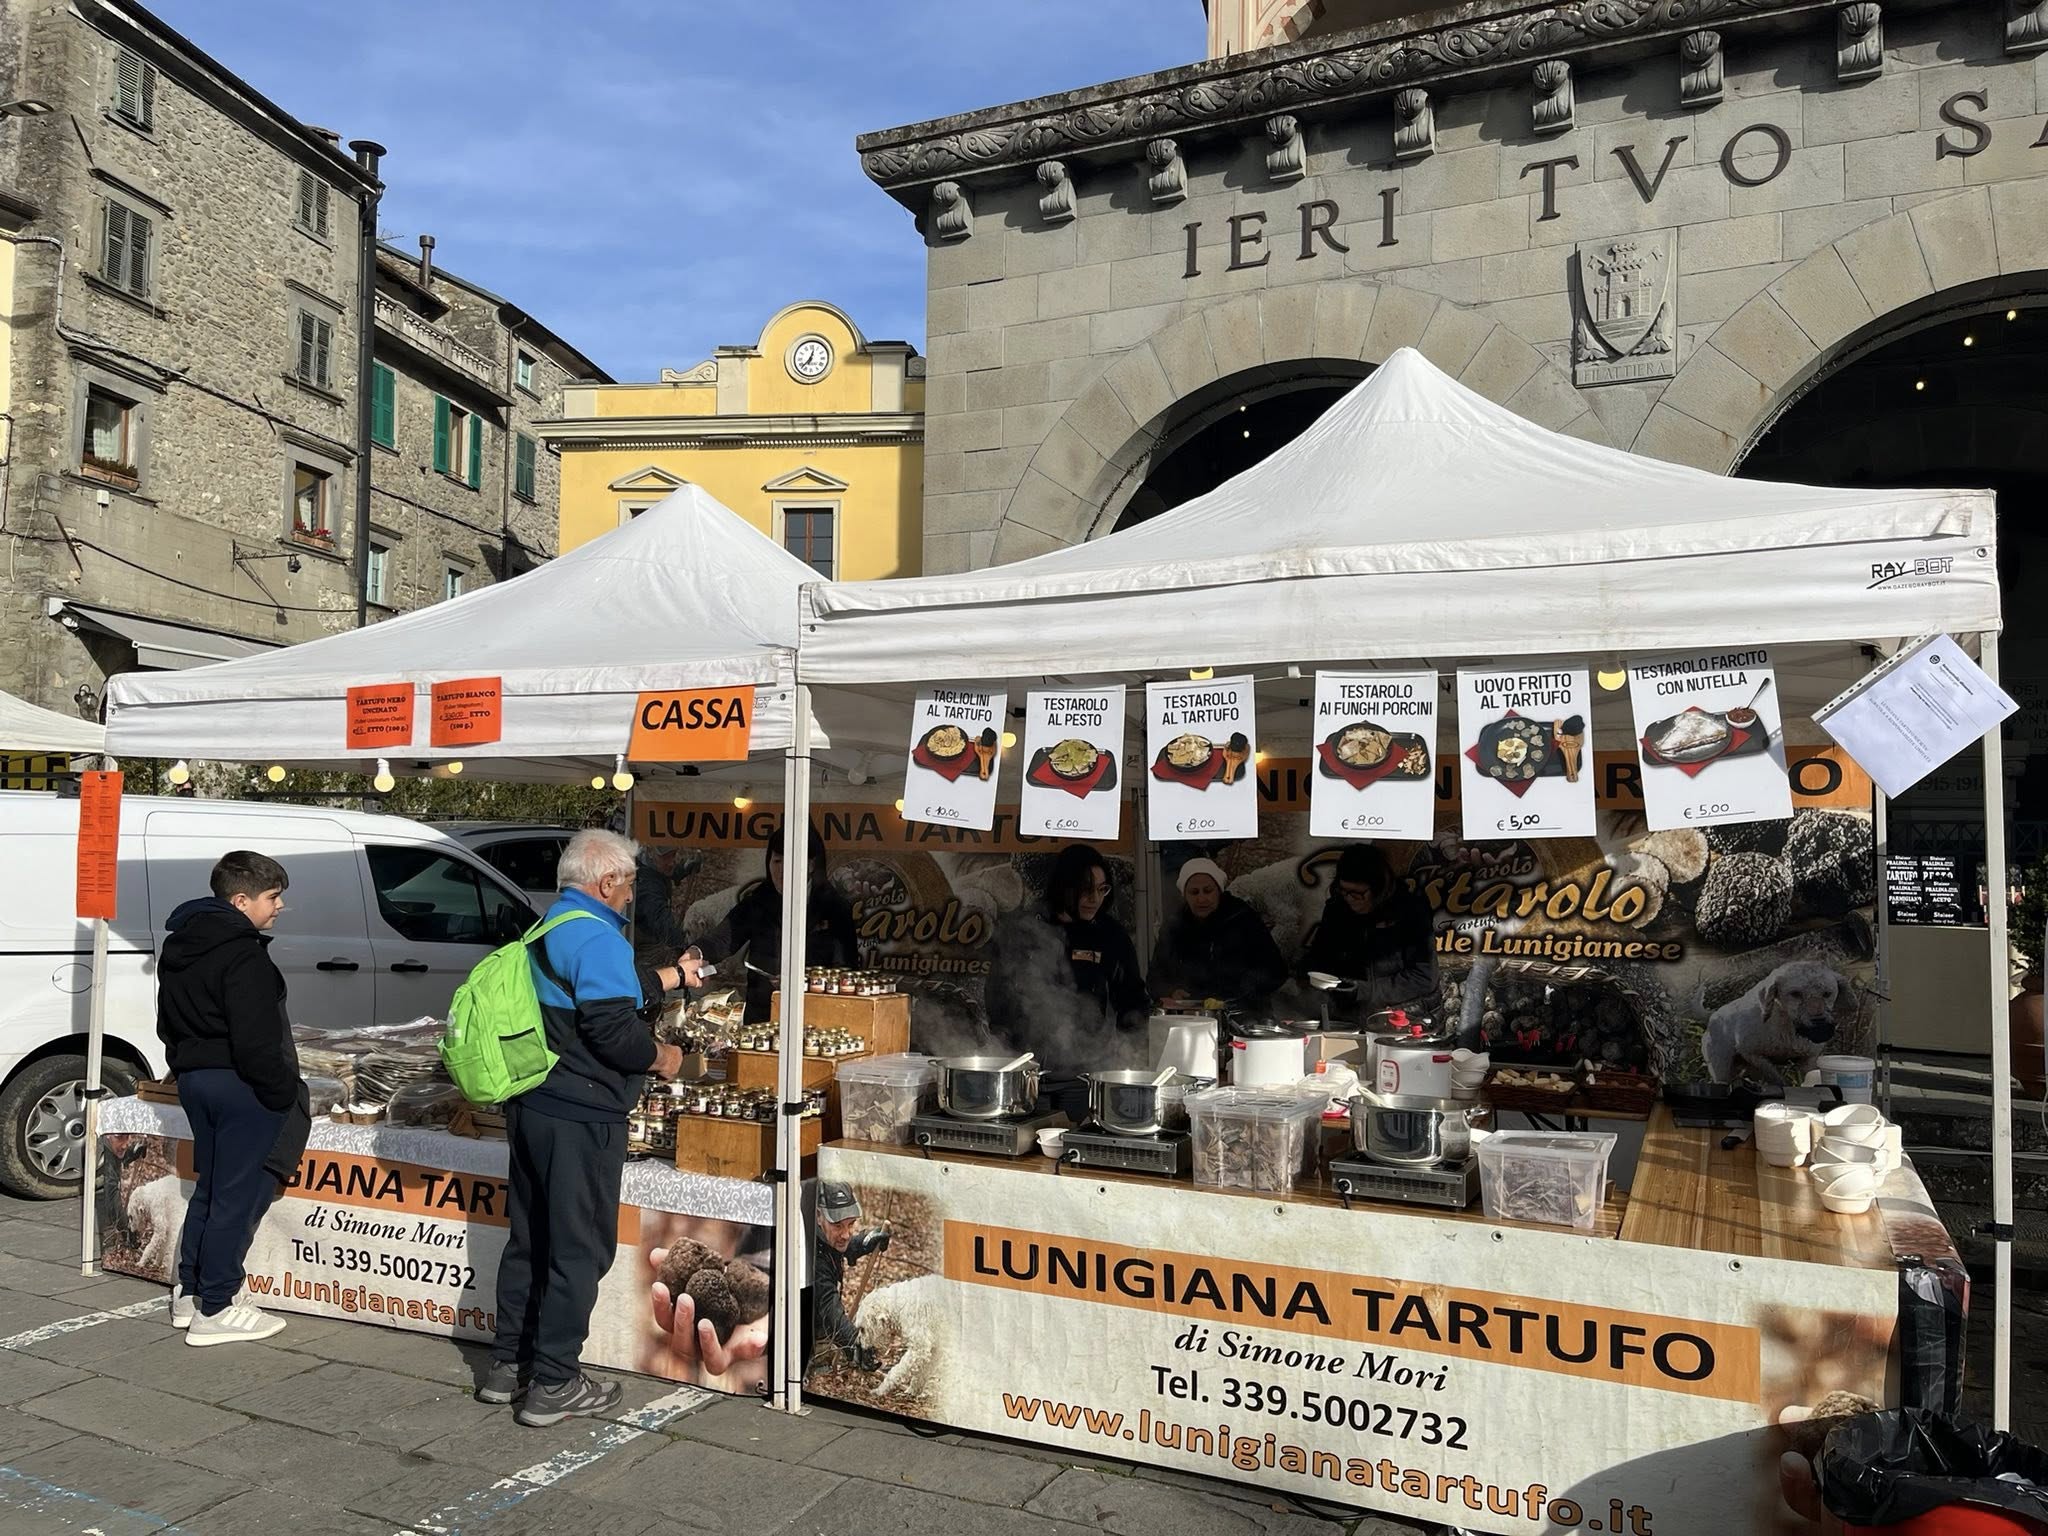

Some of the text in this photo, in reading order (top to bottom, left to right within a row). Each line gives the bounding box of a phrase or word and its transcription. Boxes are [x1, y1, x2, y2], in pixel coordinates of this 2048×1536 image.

[1181, 187, 1400, 279] IERI
[1518, 122, 1792, 222] TVO
[1583, 362, 1666, 382] FILATTIERA
[1871, 557, 1953, 579] RAY BOT
[1632, 650, 1768, 681] TESTAROLO FARCITO
[1340, 684, 1413, 699] TESTAROLO
[1474, 673, 1572, 693] UOVO FRITTO
[1656, 672, 1748, 696] CON NUTELLA
[356, 697, 386, 706] TARTUFO
[437, 690, 496, 702] TARTUFO BIANCO
[933, 690, 990, 707] TAGLIOLINI
[1044, 697, 1109, 711] TESTAROLO
[1163, 691, 1238, 709] TESTAROLO
[1480, 690, 1572, 709] AL TARTUFO
[362, 706, 398, 714] UNCINATO
[469, 710, 491, 718] ETTO
[641, 697, 746, 730] CASSA
[927, 704, 993, 722] AL TARTUFO
[1162, 707, 1240, 725] AL TARTUFO
[1319, 701, 1433, 716] AI FUNGHI PORCINI
[1047, 713, 1102, 727] AL PESTO
[649, 811, 884, 842] LUNIGNA
[1509, 813, 1540, 830] 5,00
[1481, 930, 1681, 962] Lunigianese
[868, 950, 992, 976] Lunigianes
[304, 1205, 467, 1249] di Simone Mori
[291, 1238, 476, 1291] Tel. 339.5002732
[247, 1271, 497, 1333] w.lunigianatartu
[973, 1235, 1716, 1382] LUNIGIANA TARTUFO
[1174, 1324, 1449, 1393] di Simone Mori
[1150, 1365, 1469, 1451] Tel. 339.5002732
[1002, 1391, 1653, 1536] www.lunigianatartufo.it
